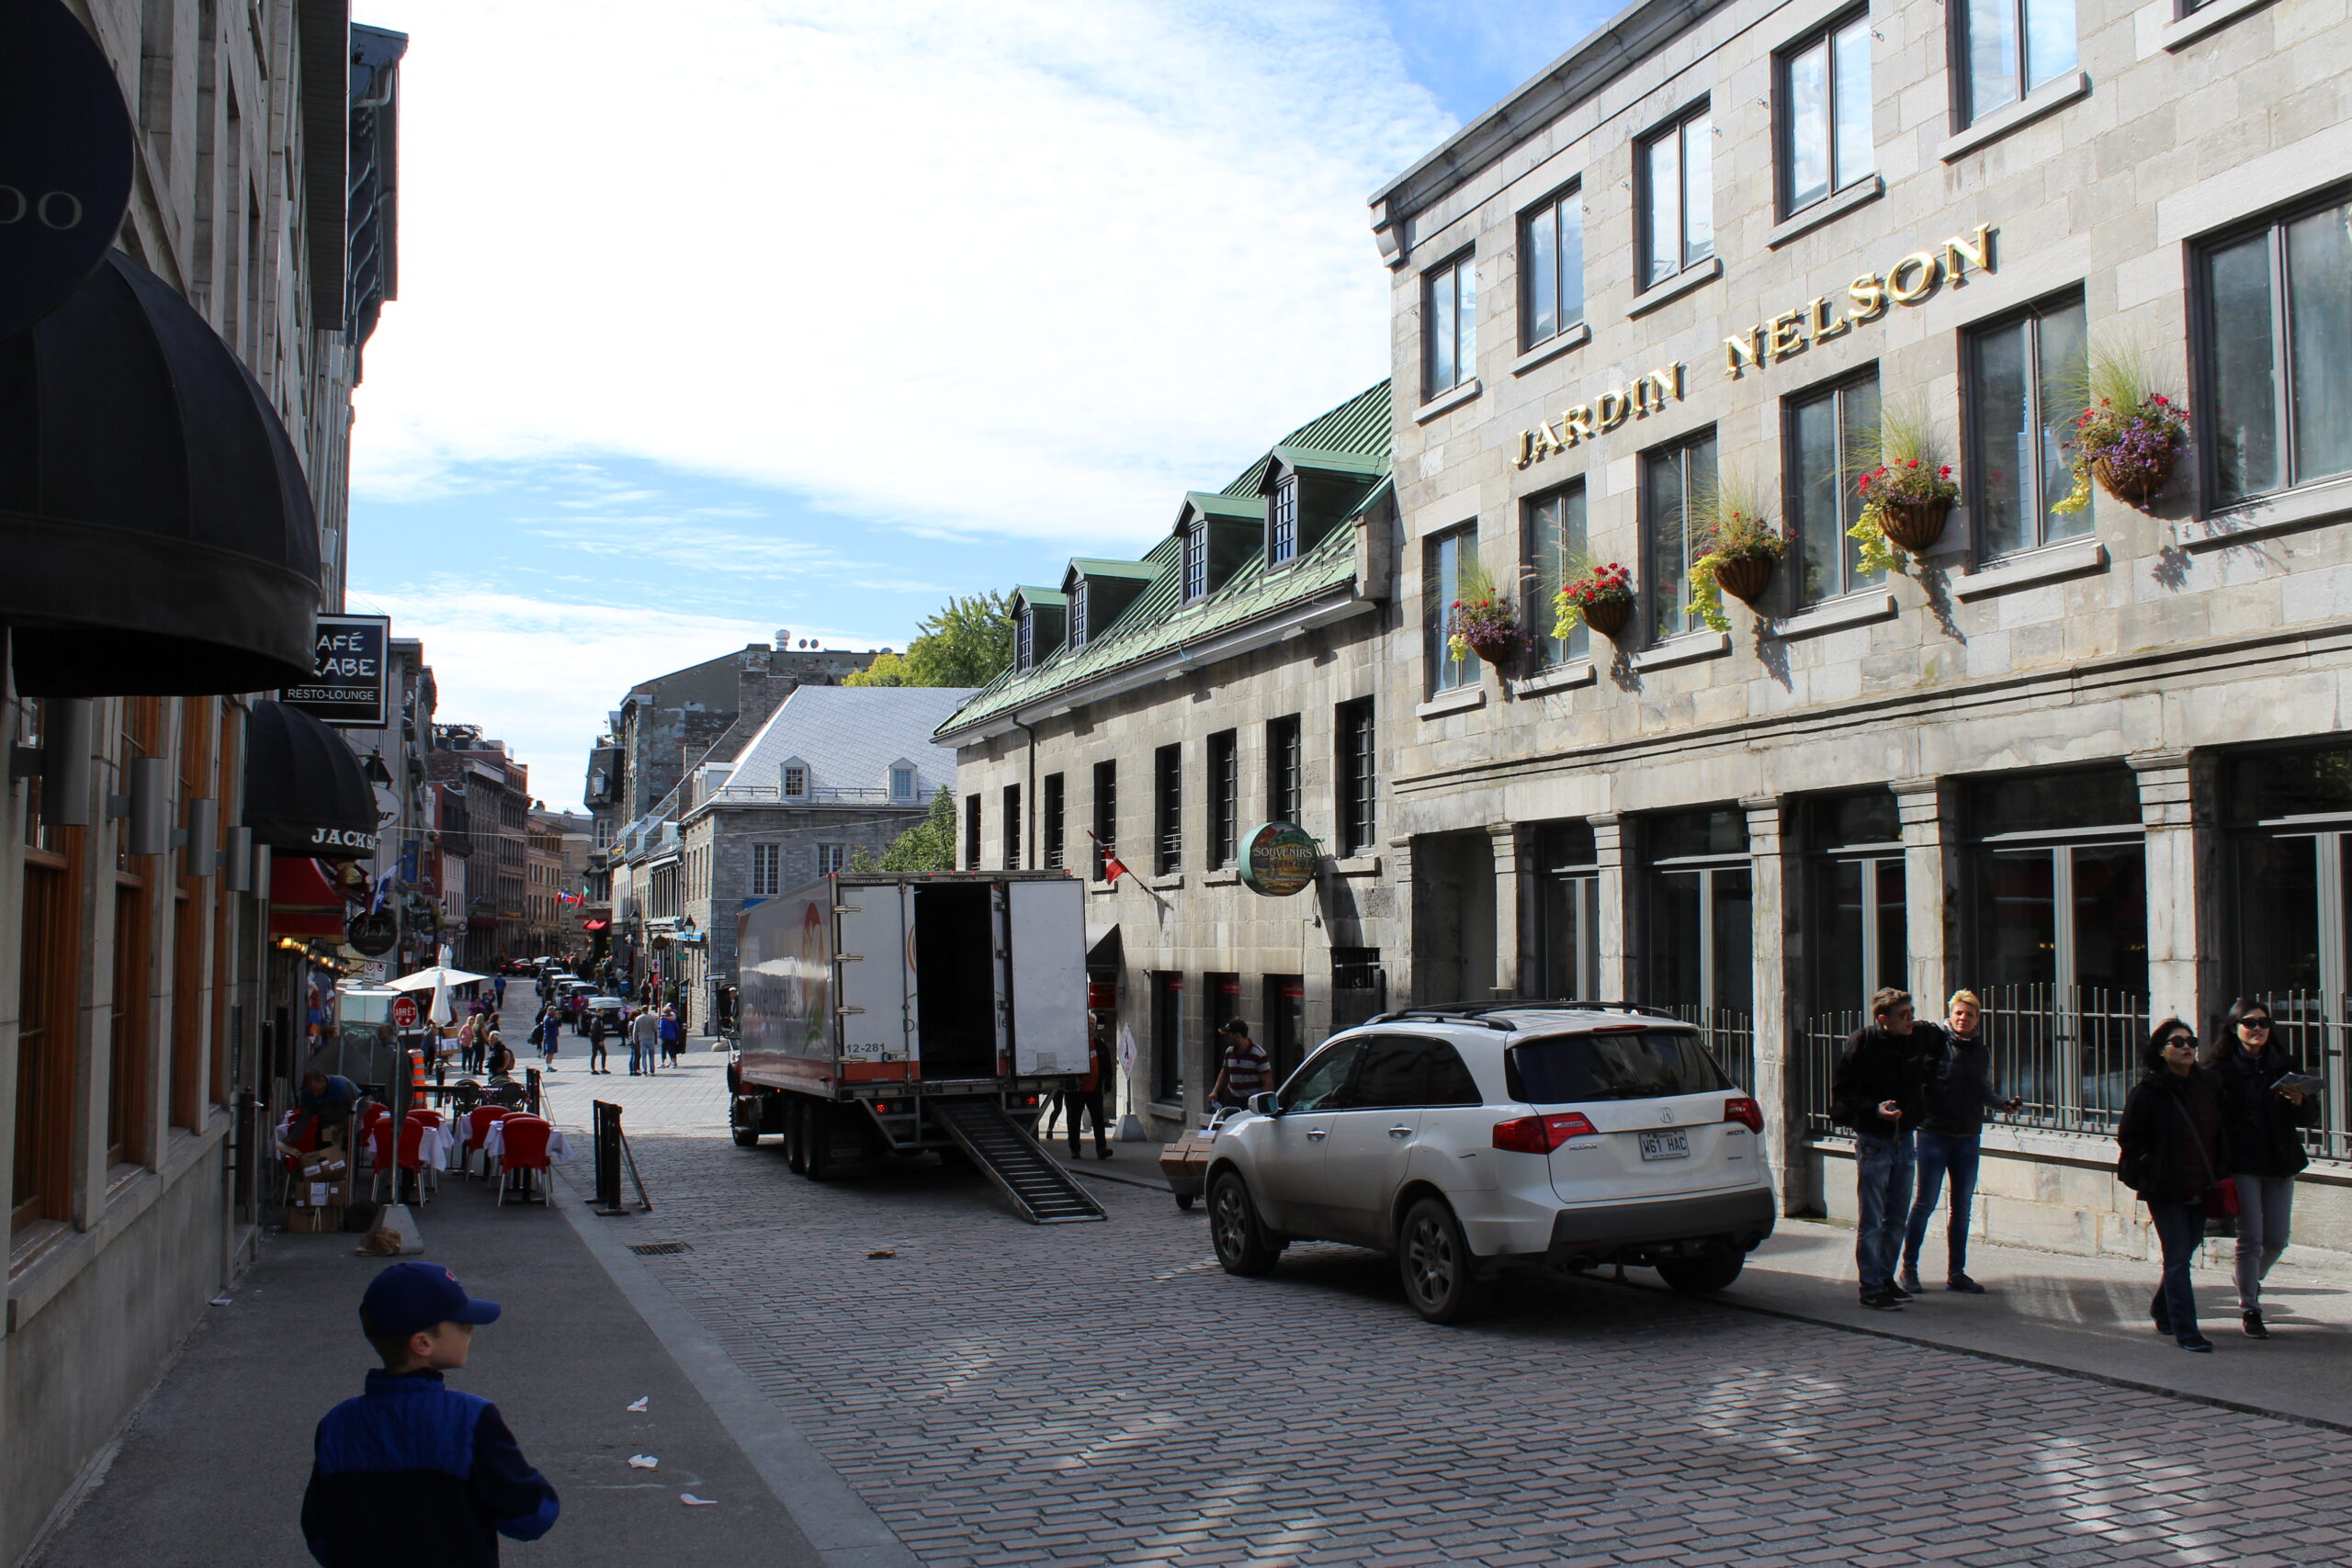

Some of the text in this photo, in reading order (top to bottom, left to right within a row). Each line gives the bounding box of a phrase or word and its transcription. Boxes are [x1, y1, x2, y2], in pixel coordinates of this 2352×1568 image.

[1510, 221, 1994, 469] JARDIN NELSON
[316, 631, 364, 651] AFÉ
[288, 689, 374, 701] RESTO-LOUNGE
[1254, 847, 1312, 859] SOUVENIRS
[395, 1006, 416, 1017] ARRÊT
[846, 1043, 885, 1054] 12-281
[1643, 1136, 1687, 1154] W61 HAC
